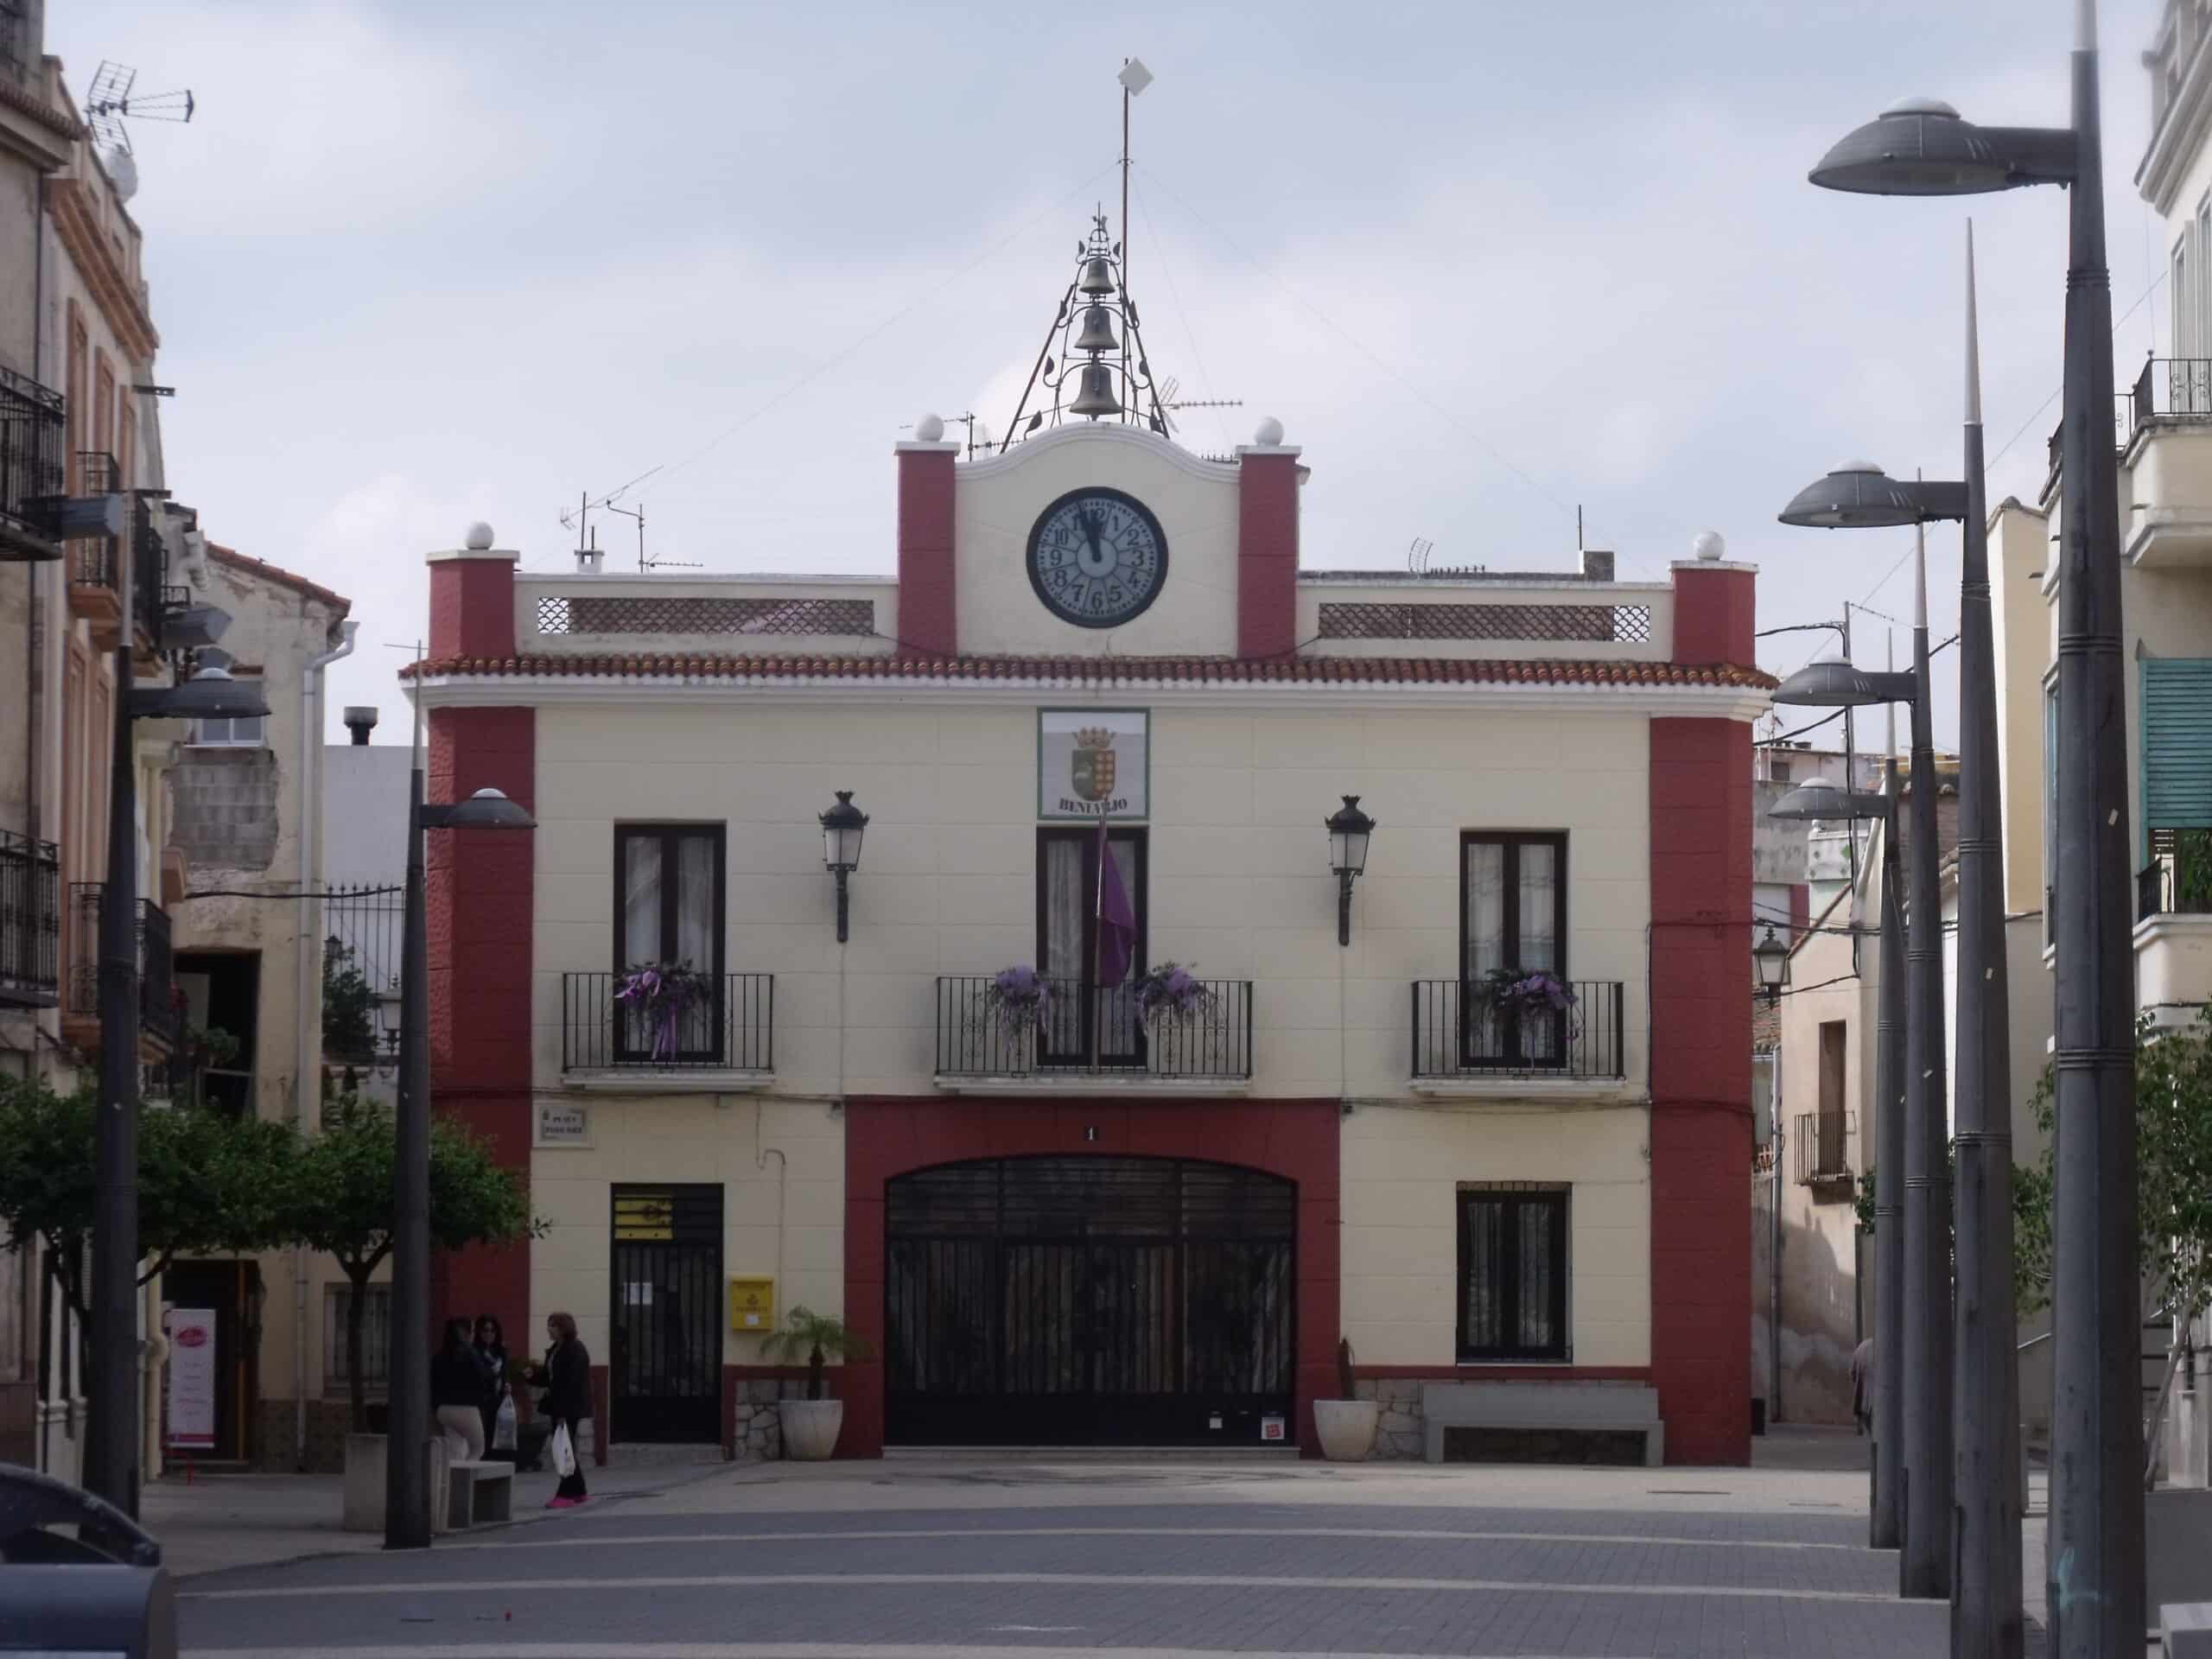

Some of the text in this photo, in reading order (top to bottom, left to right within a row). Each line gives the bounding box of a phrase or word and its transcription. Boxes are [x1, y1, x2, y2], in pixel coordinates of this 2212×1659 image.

[1113, 514, 1120, 531] 1
[1054, 528, 1069, 545] 10
[1127, 529, 1140, 546] 2
[1050, 549, 1062, 566] 9
[1132, 550, 1144, 567] 3
[1053, 569, 1067, 588] 8
[1128, 571, 1141, 589] 4
[1071, 584, 1084, 601] 7
[1091, 592, 1103, 608] 6
[1109, 585, 1122, 602] 5
